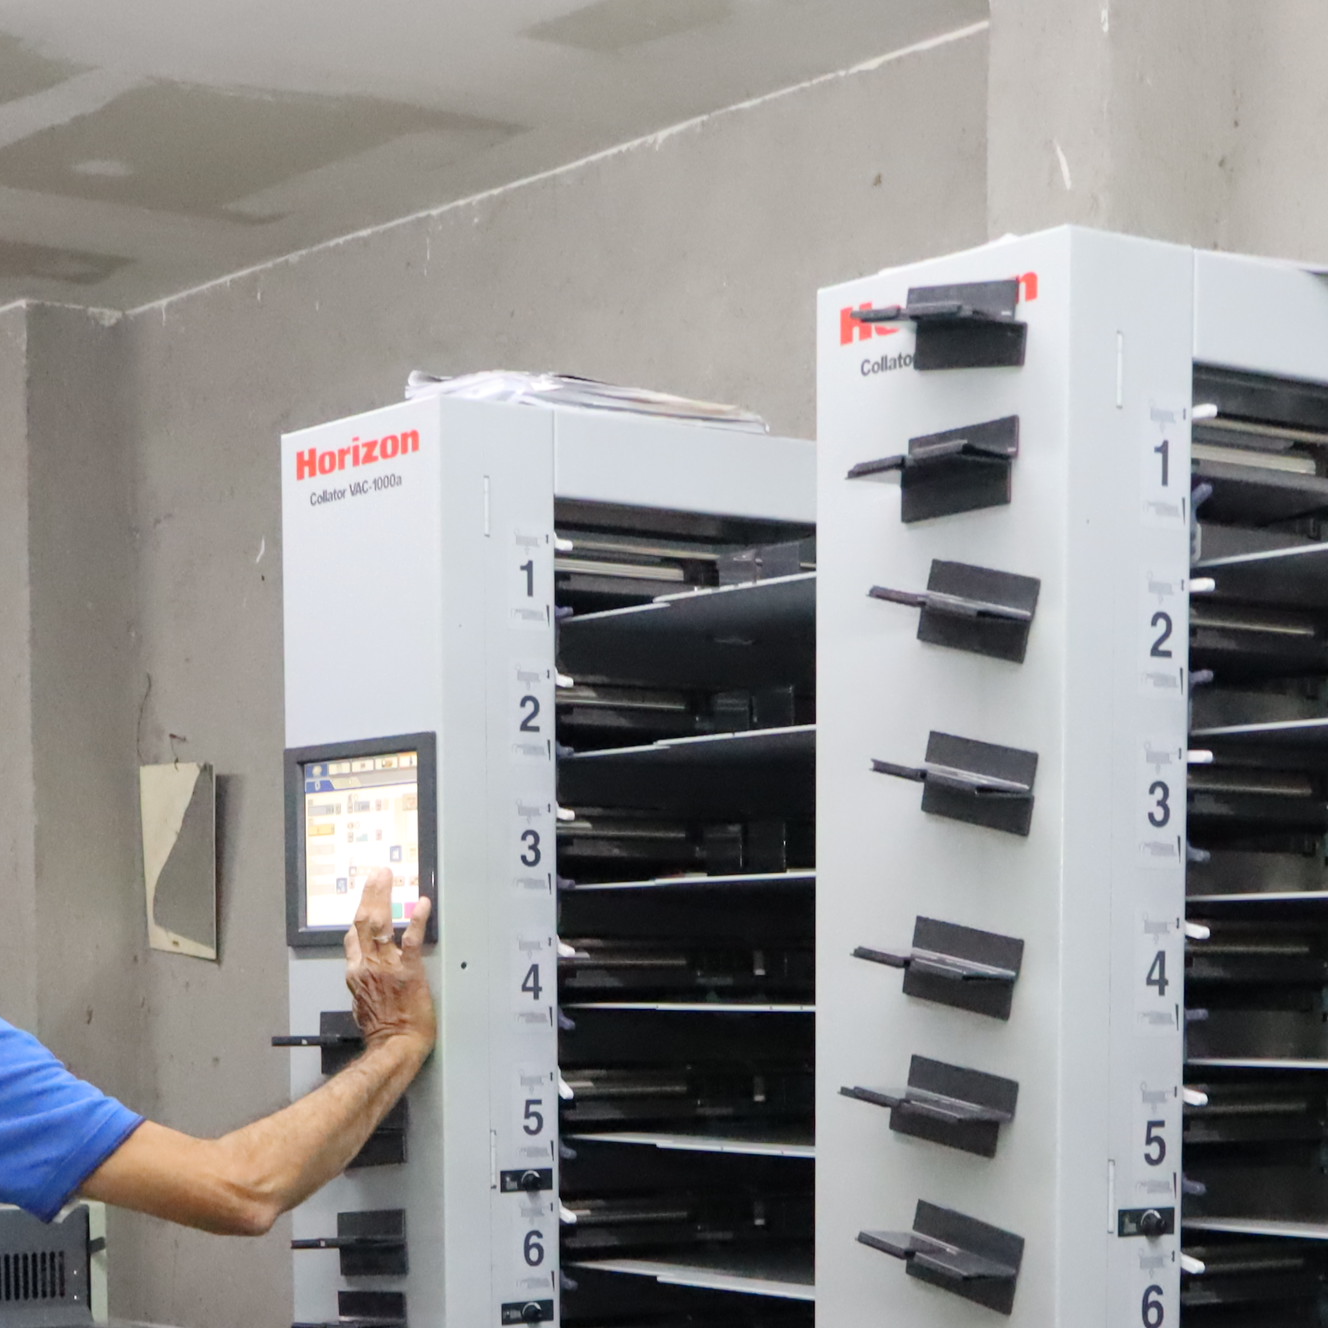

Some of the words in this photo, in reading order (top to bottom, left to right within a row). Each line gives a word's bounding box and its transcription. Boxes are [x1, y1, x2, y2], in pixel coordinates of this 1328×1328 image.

[860, 351, 915, 376] Collato
[296, 429, 420, 481] Horizon
[1154, 439, 1169, 487] 1
[309, 487, 348, 506] Collator
[349, 473, 403, 497] VAC-1000a
[519, 559, 534, 597] 1
[1150, 611, 1173, 659] 2
[519, 695, 541, 733] 2
[1147, 780, 1171, 828] 3
[520, 829, 541, 868] 3
[521, 963, 543, 1001] 4
[1145, 950, 1169, 997] 4
[522, 1099, 544, 1136] 5
[1144, 1119, 1167, 1167] 5
[523, 1229, 545, 1267] 6
